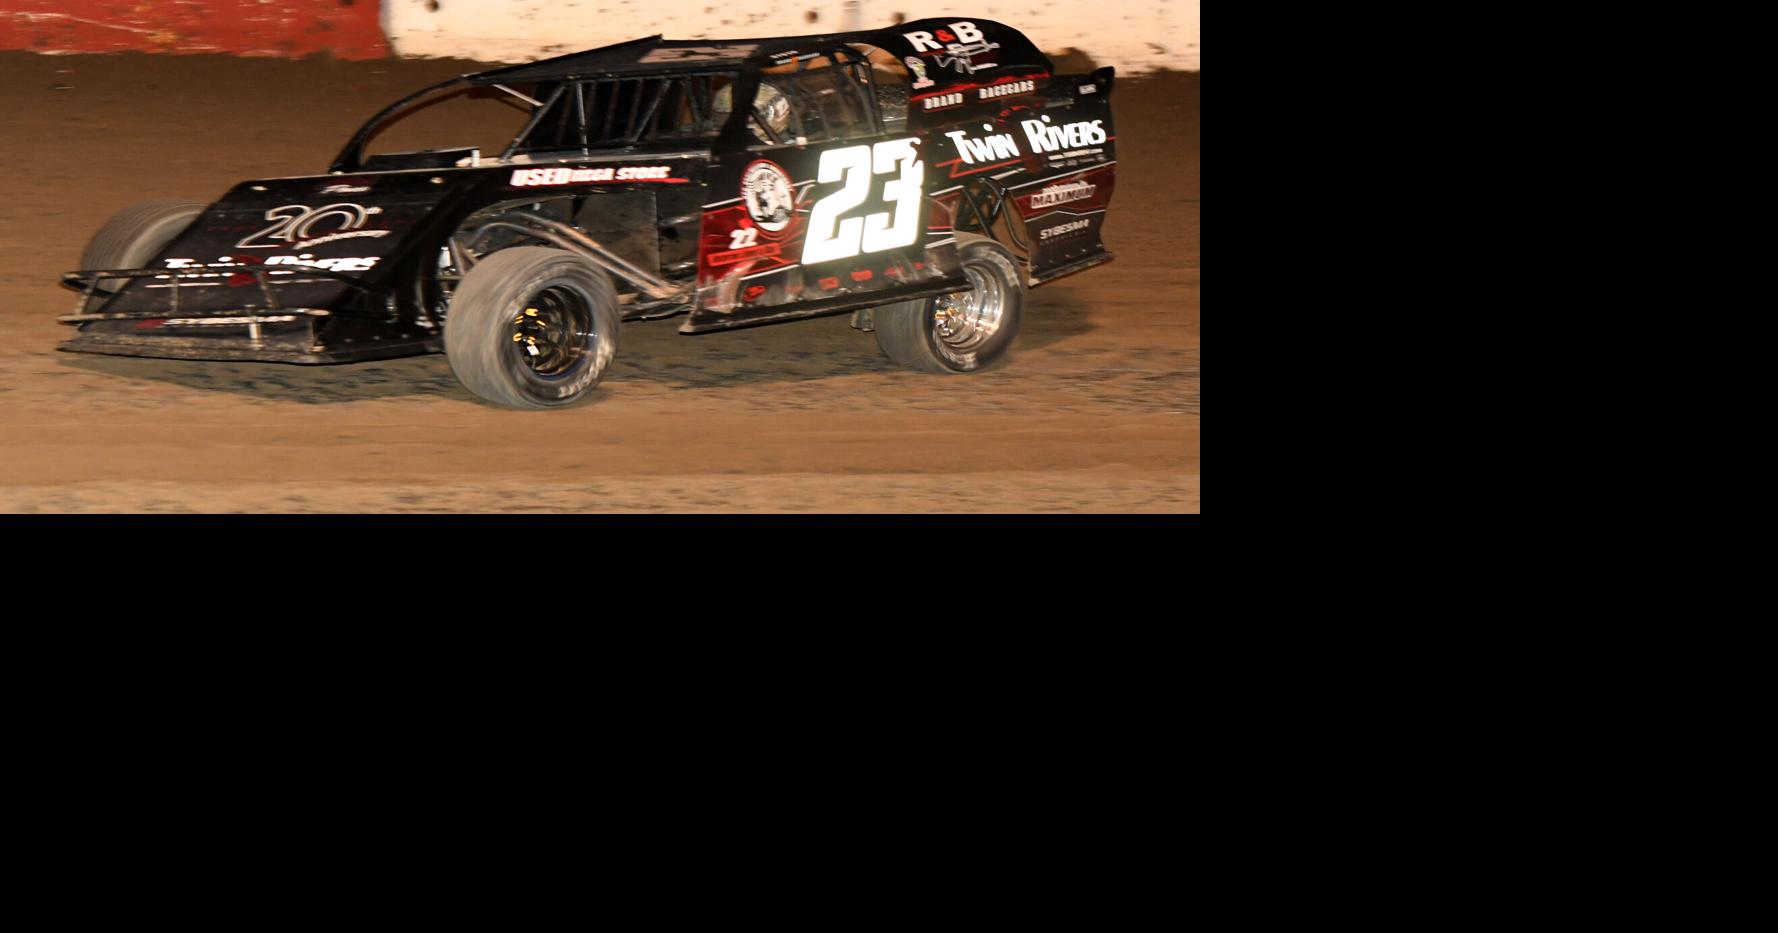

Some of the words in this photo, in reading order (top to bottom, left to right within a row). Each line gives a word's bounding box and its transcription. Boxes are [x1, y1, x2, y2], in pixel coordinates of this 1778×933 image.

[903, 21, 984, 52] R&B
[924, 93, 963, 109] BRAND
[979, 80, 1035, 99] RACECARS
[510, 168, 571, 187] USED
[801, 137, 924, 265] 23
